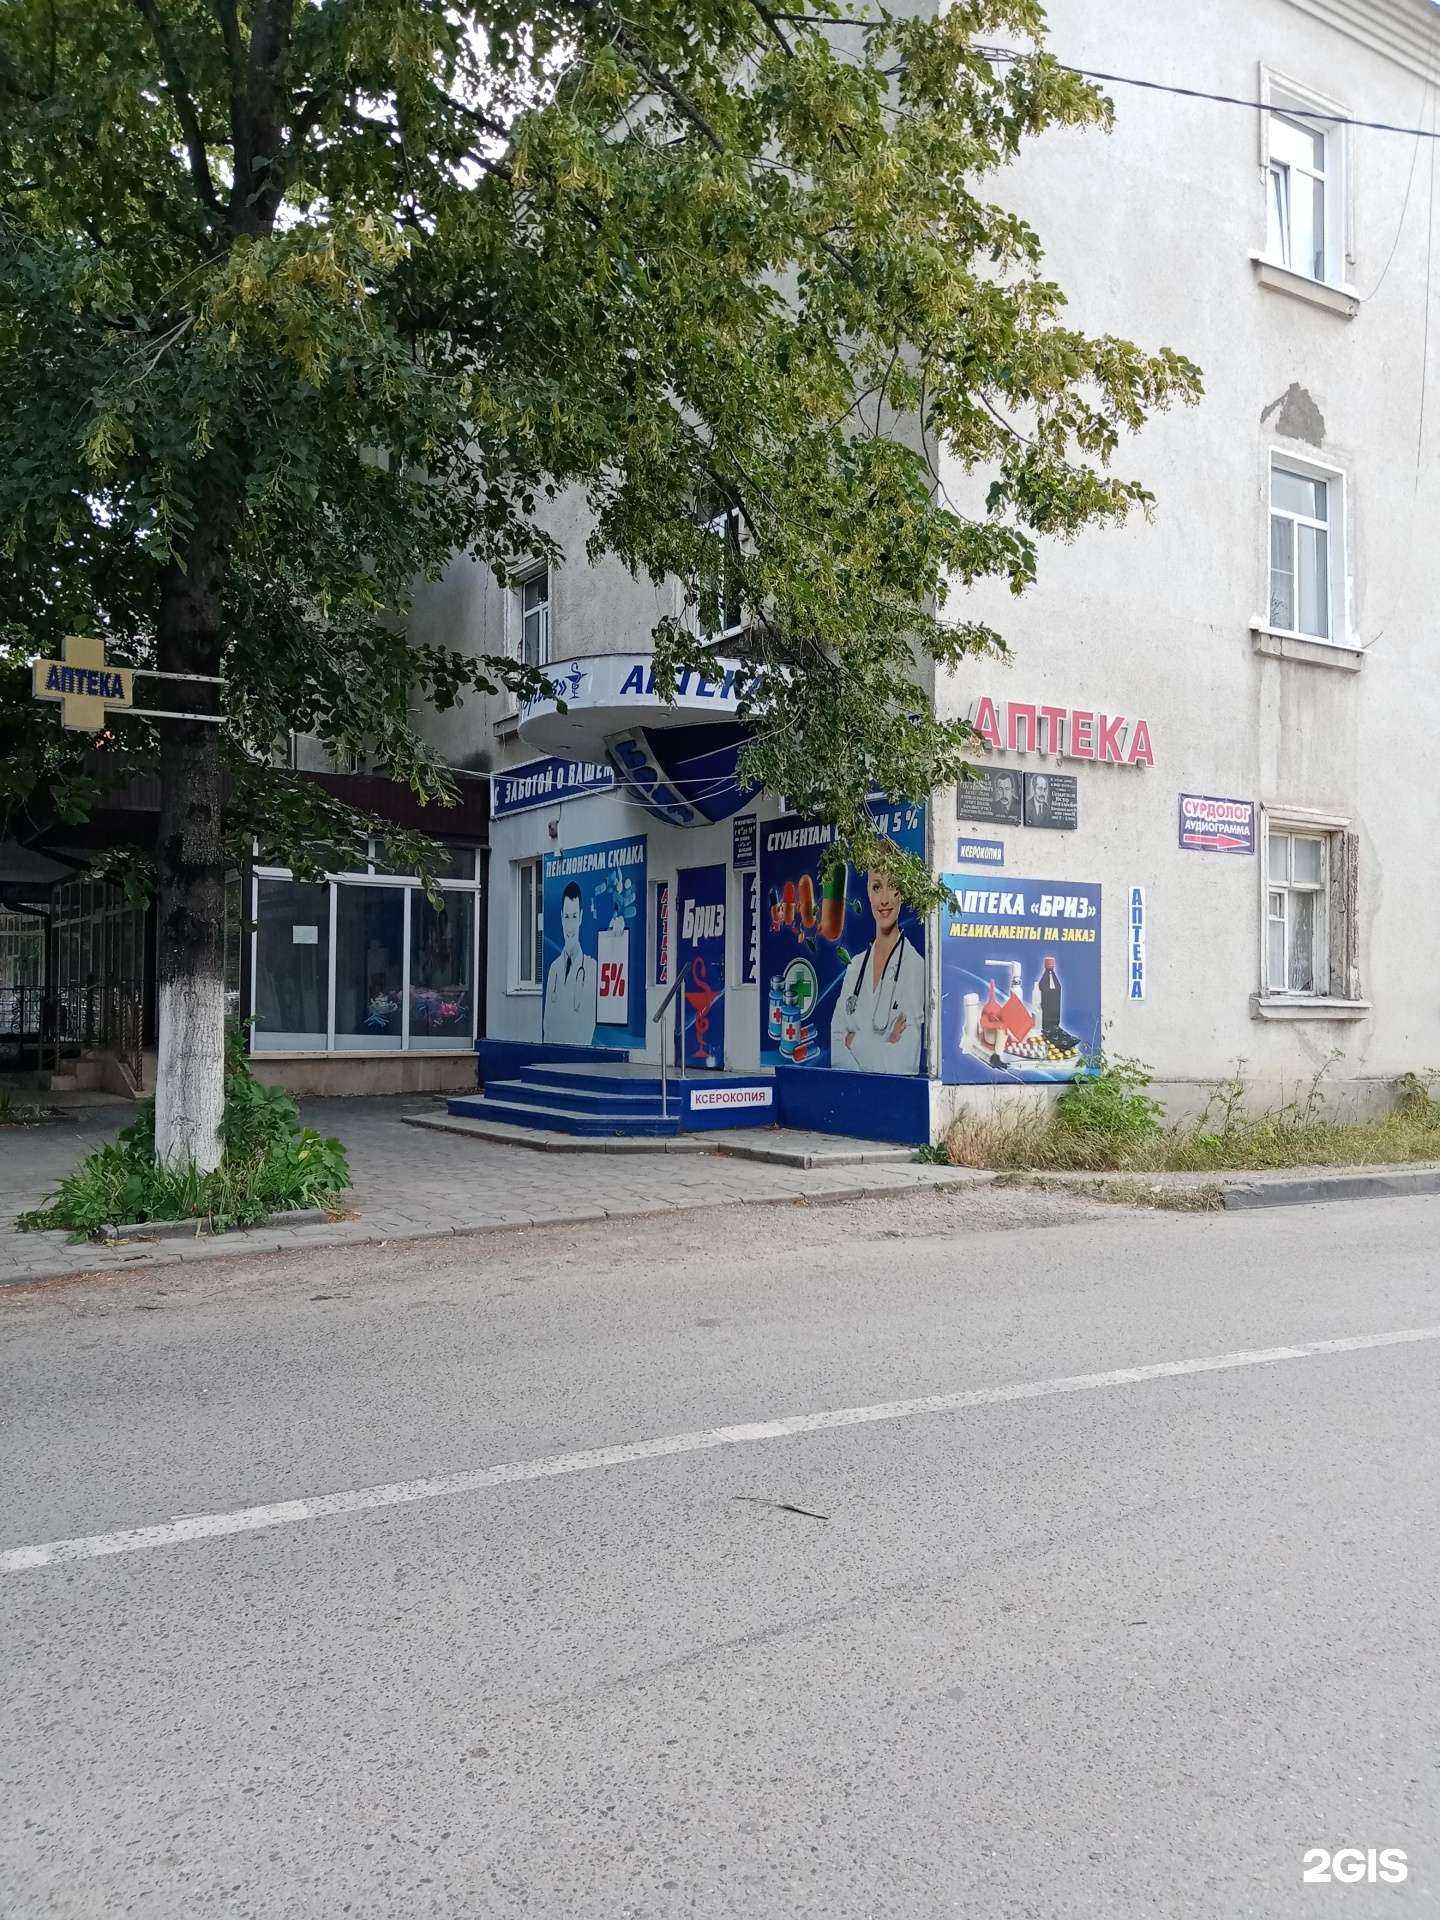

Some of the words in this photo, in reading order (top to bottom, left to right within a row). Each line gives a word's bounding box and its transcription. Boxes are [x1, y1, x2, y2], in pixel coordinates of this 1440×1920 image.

[47, 664, 125, 699] АПТЕКА
[972, 695, 1157, 768] АПТЕКА
[504, 766, 554, 804] ЗАБОТОЙ
[556, 767, 565, 790] О
[1182, 798, 1251, 823] СУРДОЛОГ
[767, 825, 831, 851] СТУДЕНТАМ
[1184, 820, 1251, 836] АУДИОГРАММА
[546, 852, 606, 878] ПЕНСИОНЕРАМ
[607, 845, 644, 868] СКИДКА
[961, 845, 1002, 861] КСЕРОКОПИЯ
[1030, 894, 1097, 919] «БРИЗ»
[681, 898, 725, 947] Бриз
[949, 922, 1041, 941] МЕДИКАМЕНТЫ
[1044, 928, 1059, 942] НА
[1061, 928, 1096, 942] ЗАКАЗ
[1130, 888, 1143, 999] АПТЕКА
[599, 962, 626, 998] 5%
[694, 1090, 766, 1105] КСЕРОКОПИЯ
